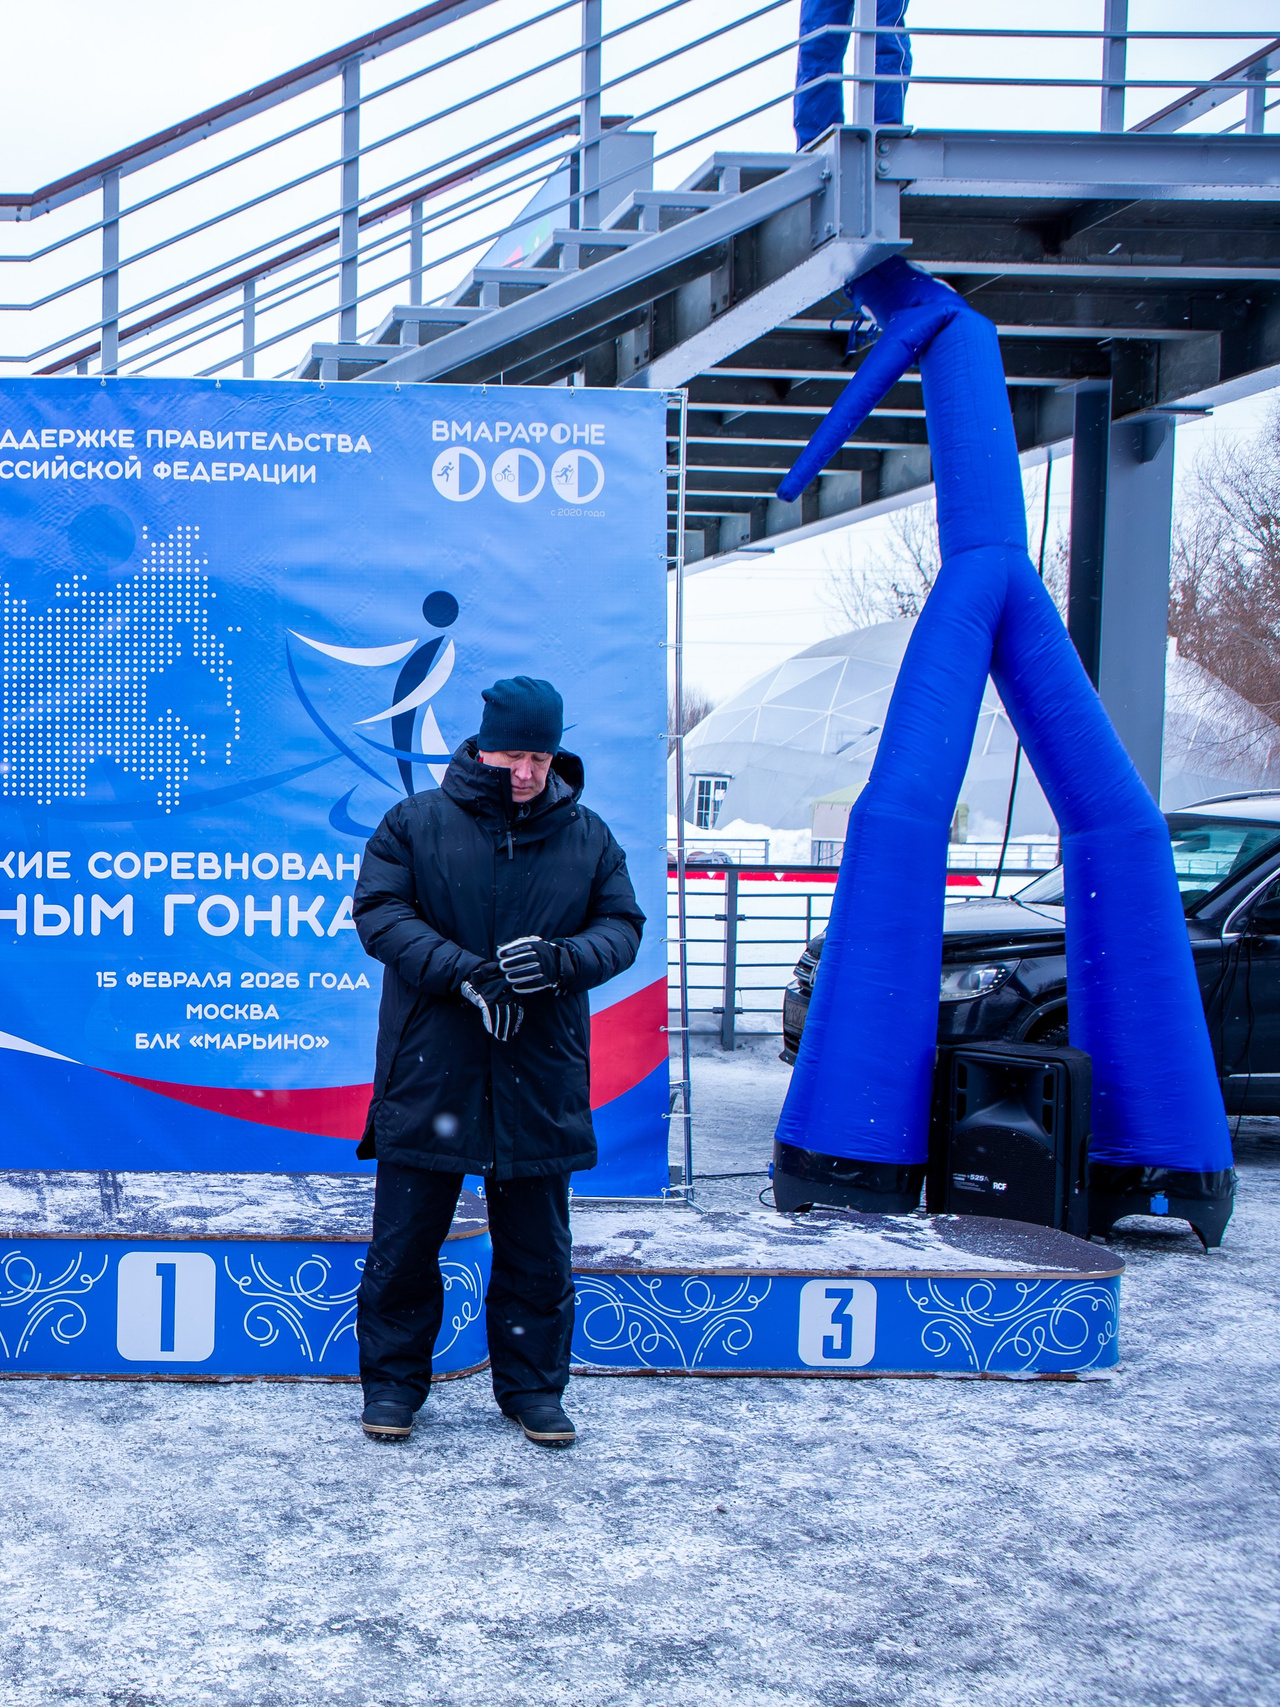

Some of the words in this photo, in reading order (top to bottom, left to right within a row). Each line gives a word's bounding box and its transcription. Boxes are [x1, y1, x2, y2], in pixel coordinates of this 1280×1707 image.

[146, 429, 372, 453] ПРАВИТЕЛЬСТВА
[432, 420, 605, 445] ВМАРАФОНЕ
[153, 461, 316, 485] ФЕДЕРАЦИИ
[557, 508, 582, 517] 2020
[584, 509, 605, 518] года
[96, 971, 117, 988] 15
[126, 971, 231, 988] ФЕВРАЛЯ
[240, 972, 300, 988] 2026
[309, 972, 370, 991] ГОДА
[186, 1003, 279, 1020] МОСКВА
[135, 1033, 181, 1049] БЛК
[189, 1033, 330, 1050] «МАРЬИНО»
[992, 1182, 1007, 1190] RCF
[155, 1262, 174, 1353] 1
[822, 1288, 854, 1359] 3
